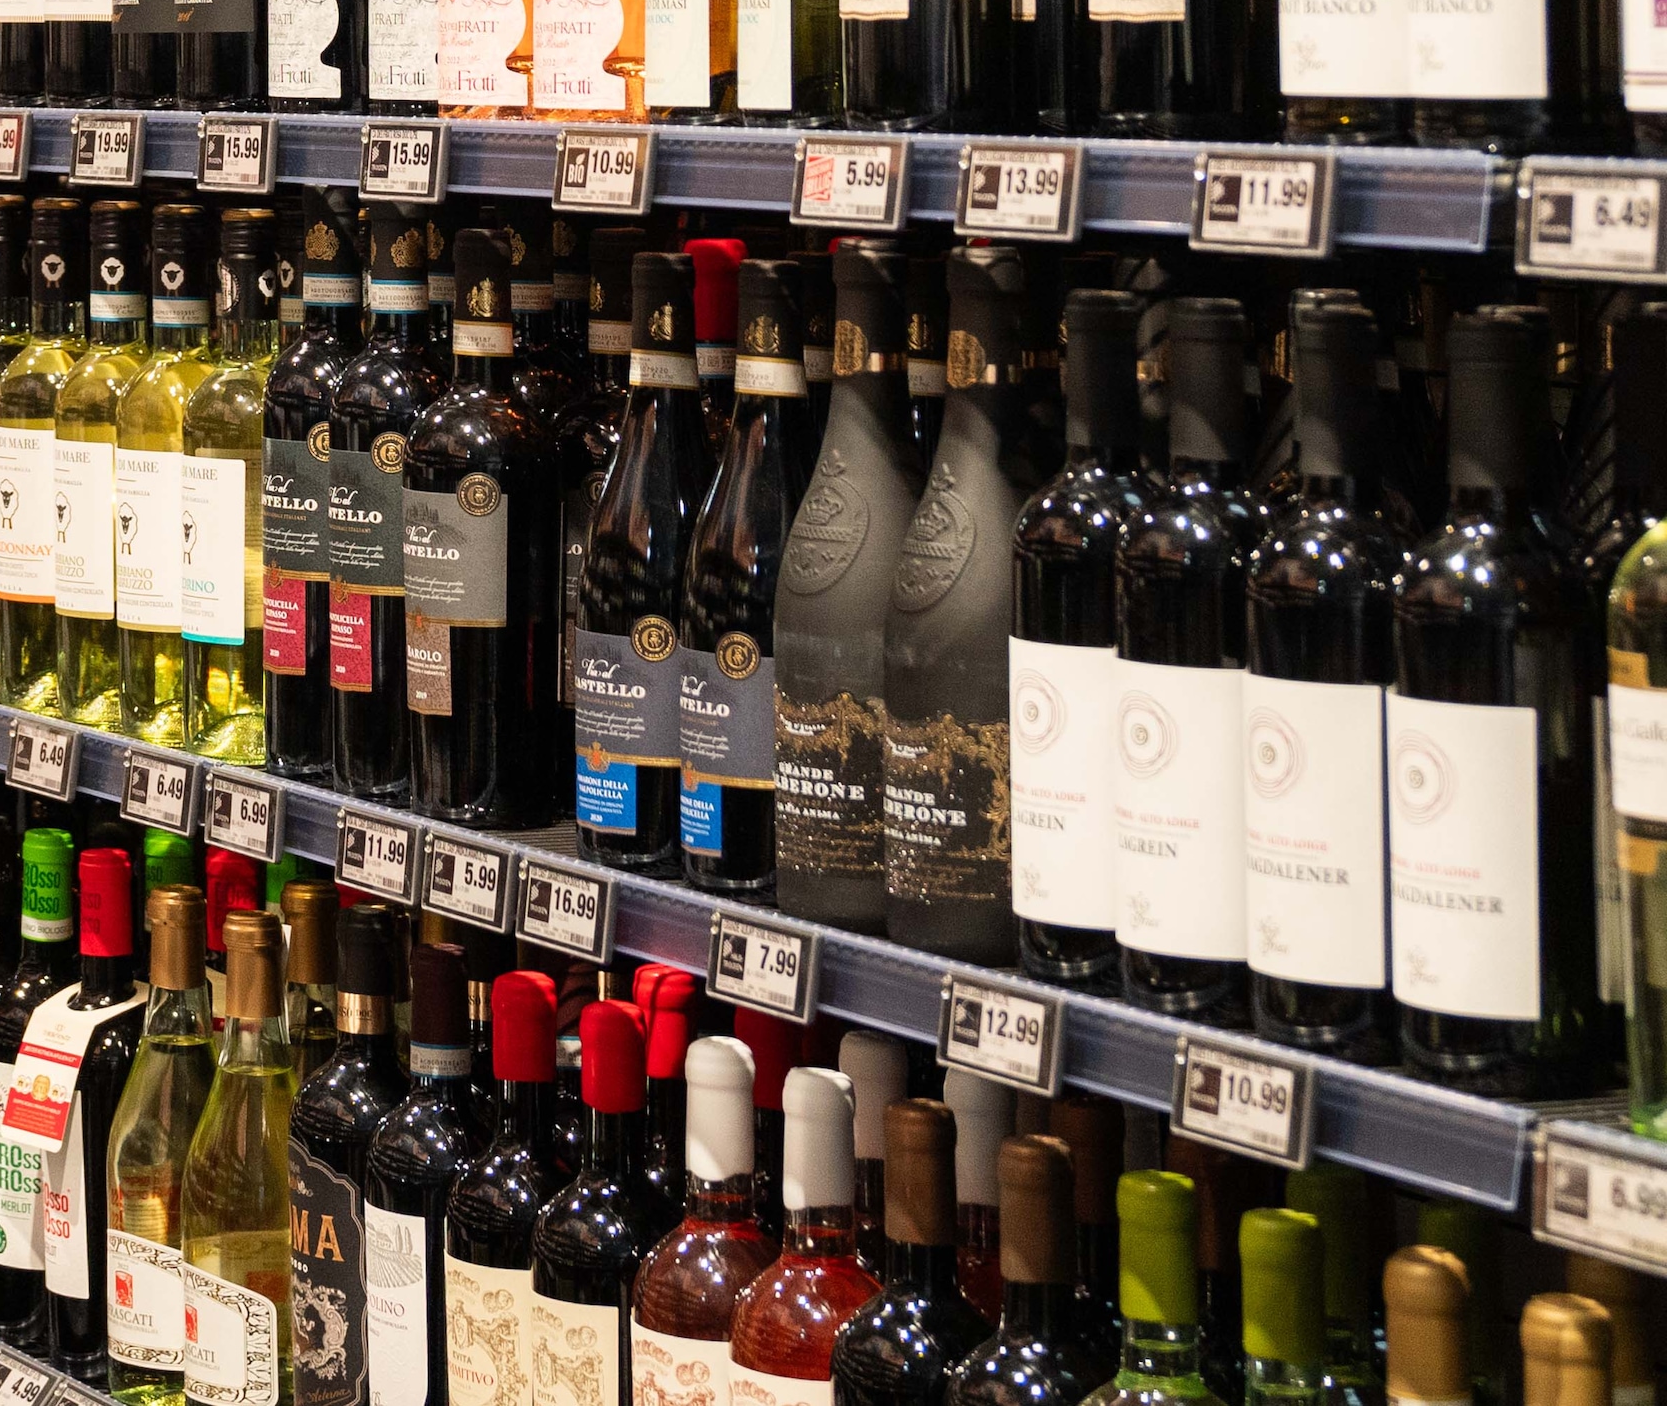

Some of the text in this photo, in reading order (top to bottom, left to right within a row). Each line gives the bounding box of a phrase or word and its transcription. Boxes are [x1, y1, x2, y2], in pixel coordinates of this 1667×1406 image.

[97, 131, 129, 154] 19.99
[225, 136, 260, 160] 15.99
[391, 141, 431, 166] 15.99
[567, 162, 584, 184] BIO
[591, 149, 635, 175] 10.99
[845, 159, 887, 187] 5.99
[1004, 167, 1059, 195] 13.99
[1246, 176, 1309, 207] 11.99
[1594, 198, 1653, 229] 6.49
[9, 436, 41, 451] MARE
[62, 449, 91, 465] MARE
[128, 458, 159, 474] MARE
[191, 467, 218, 482] MARE
[407, 645, 442, 663] BAROLO
[39, 742, 65, 769] 6.49
[603, 778, 629, 791] DELLA
[778, 760, 834, 782] GRANDE
[156, 773, 184, 800] 6.49
[240, 797, 267, 825] 6.99
[367, 833, 406, 867] 11.99
[464, 860, 498, 893] 5.99
[553, 885, 596, 922] 16.99
[759, 943, 798, 979] 7.99
[985, 1009, 1042, 1046] 12.99
[1225, 1073, 1289, 1116] 10.99
[0, 1198, 32, 1215] MERLOT
[11, 1376, 42, 1403] 4.99
